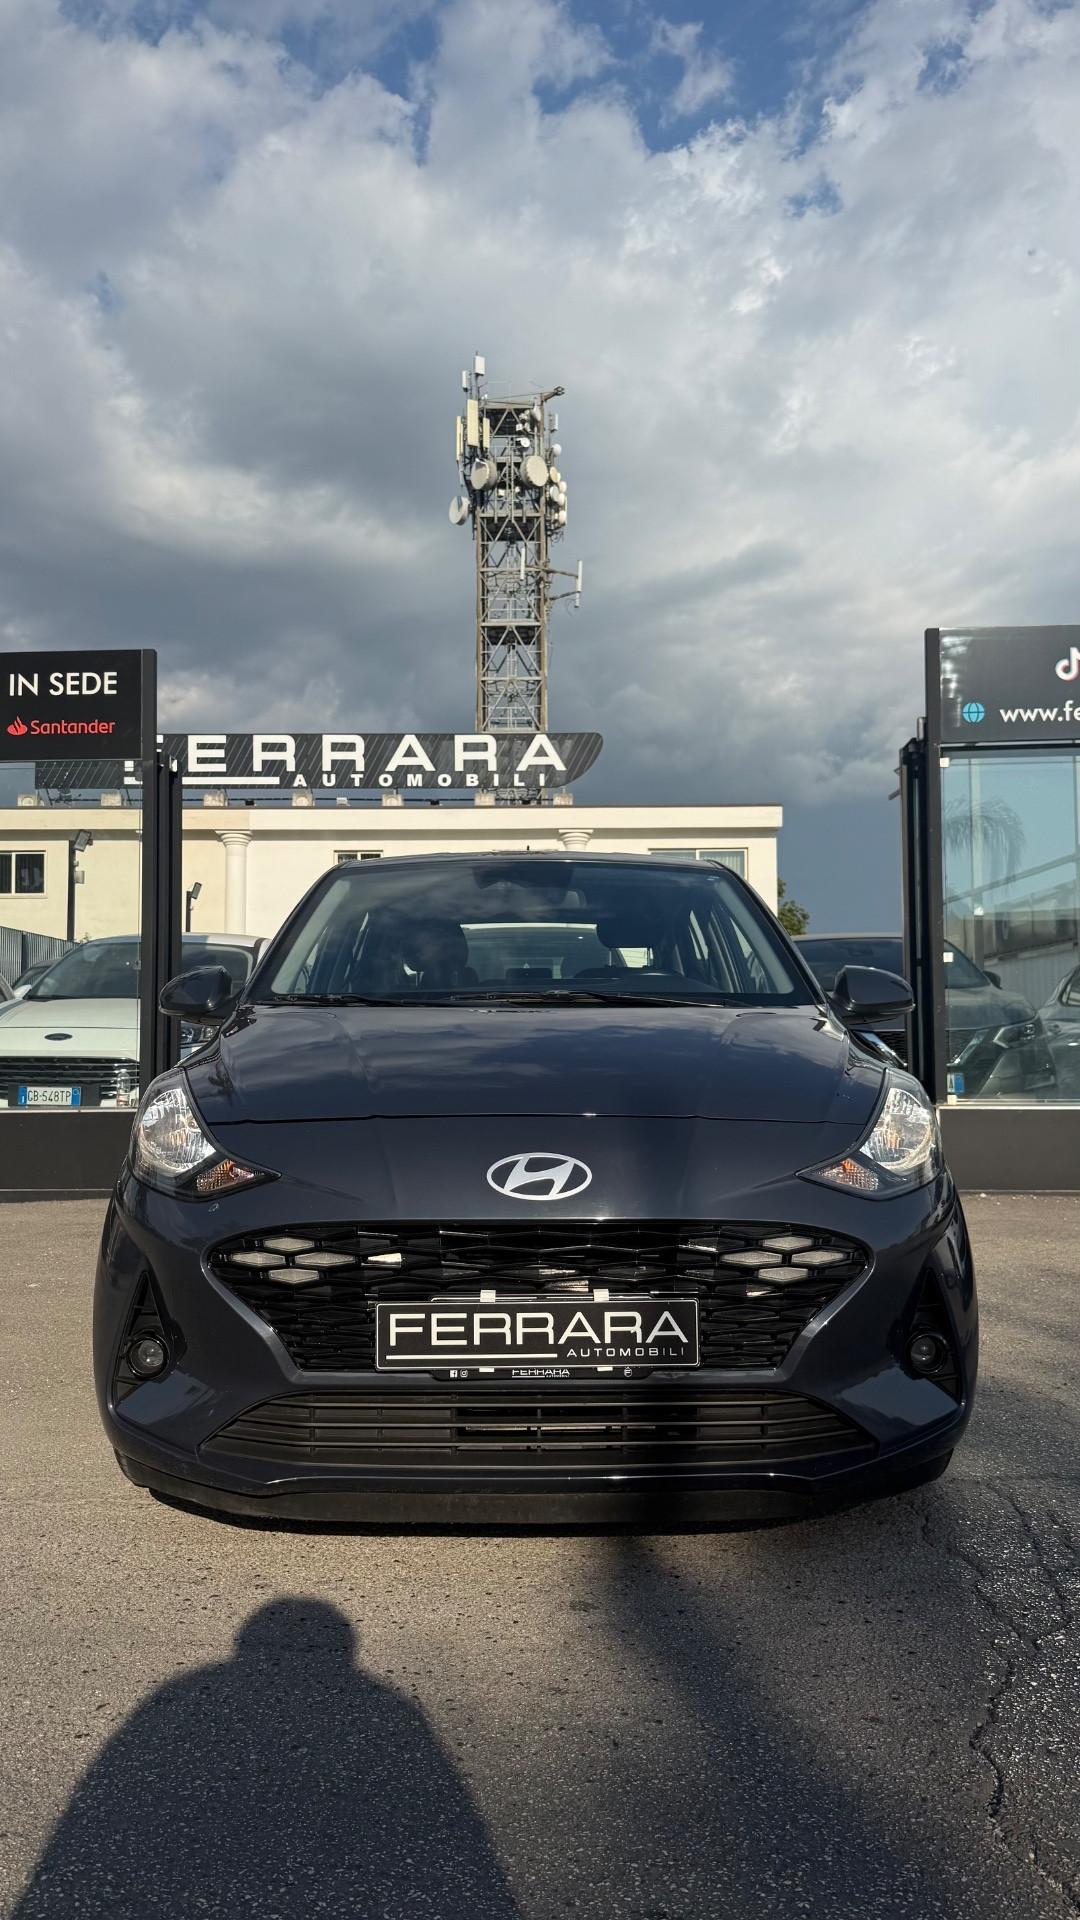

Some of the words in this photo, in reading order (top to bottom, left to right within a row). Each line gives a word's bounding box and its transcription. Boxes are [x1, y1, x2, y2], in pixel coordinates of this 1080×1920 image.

[9, 673, 38, 696] IN
[49, 672, 117, 695] SEDE
[31, 718, 116, 735] Santander
[124, 734, 566, 772] ERRARA
[293, 773, 546, 787] AUTOMOBILI
[389, 1311, 688, 1346] FERRARA
[566, 1347, 684, 1357] AUTOMOBILI
